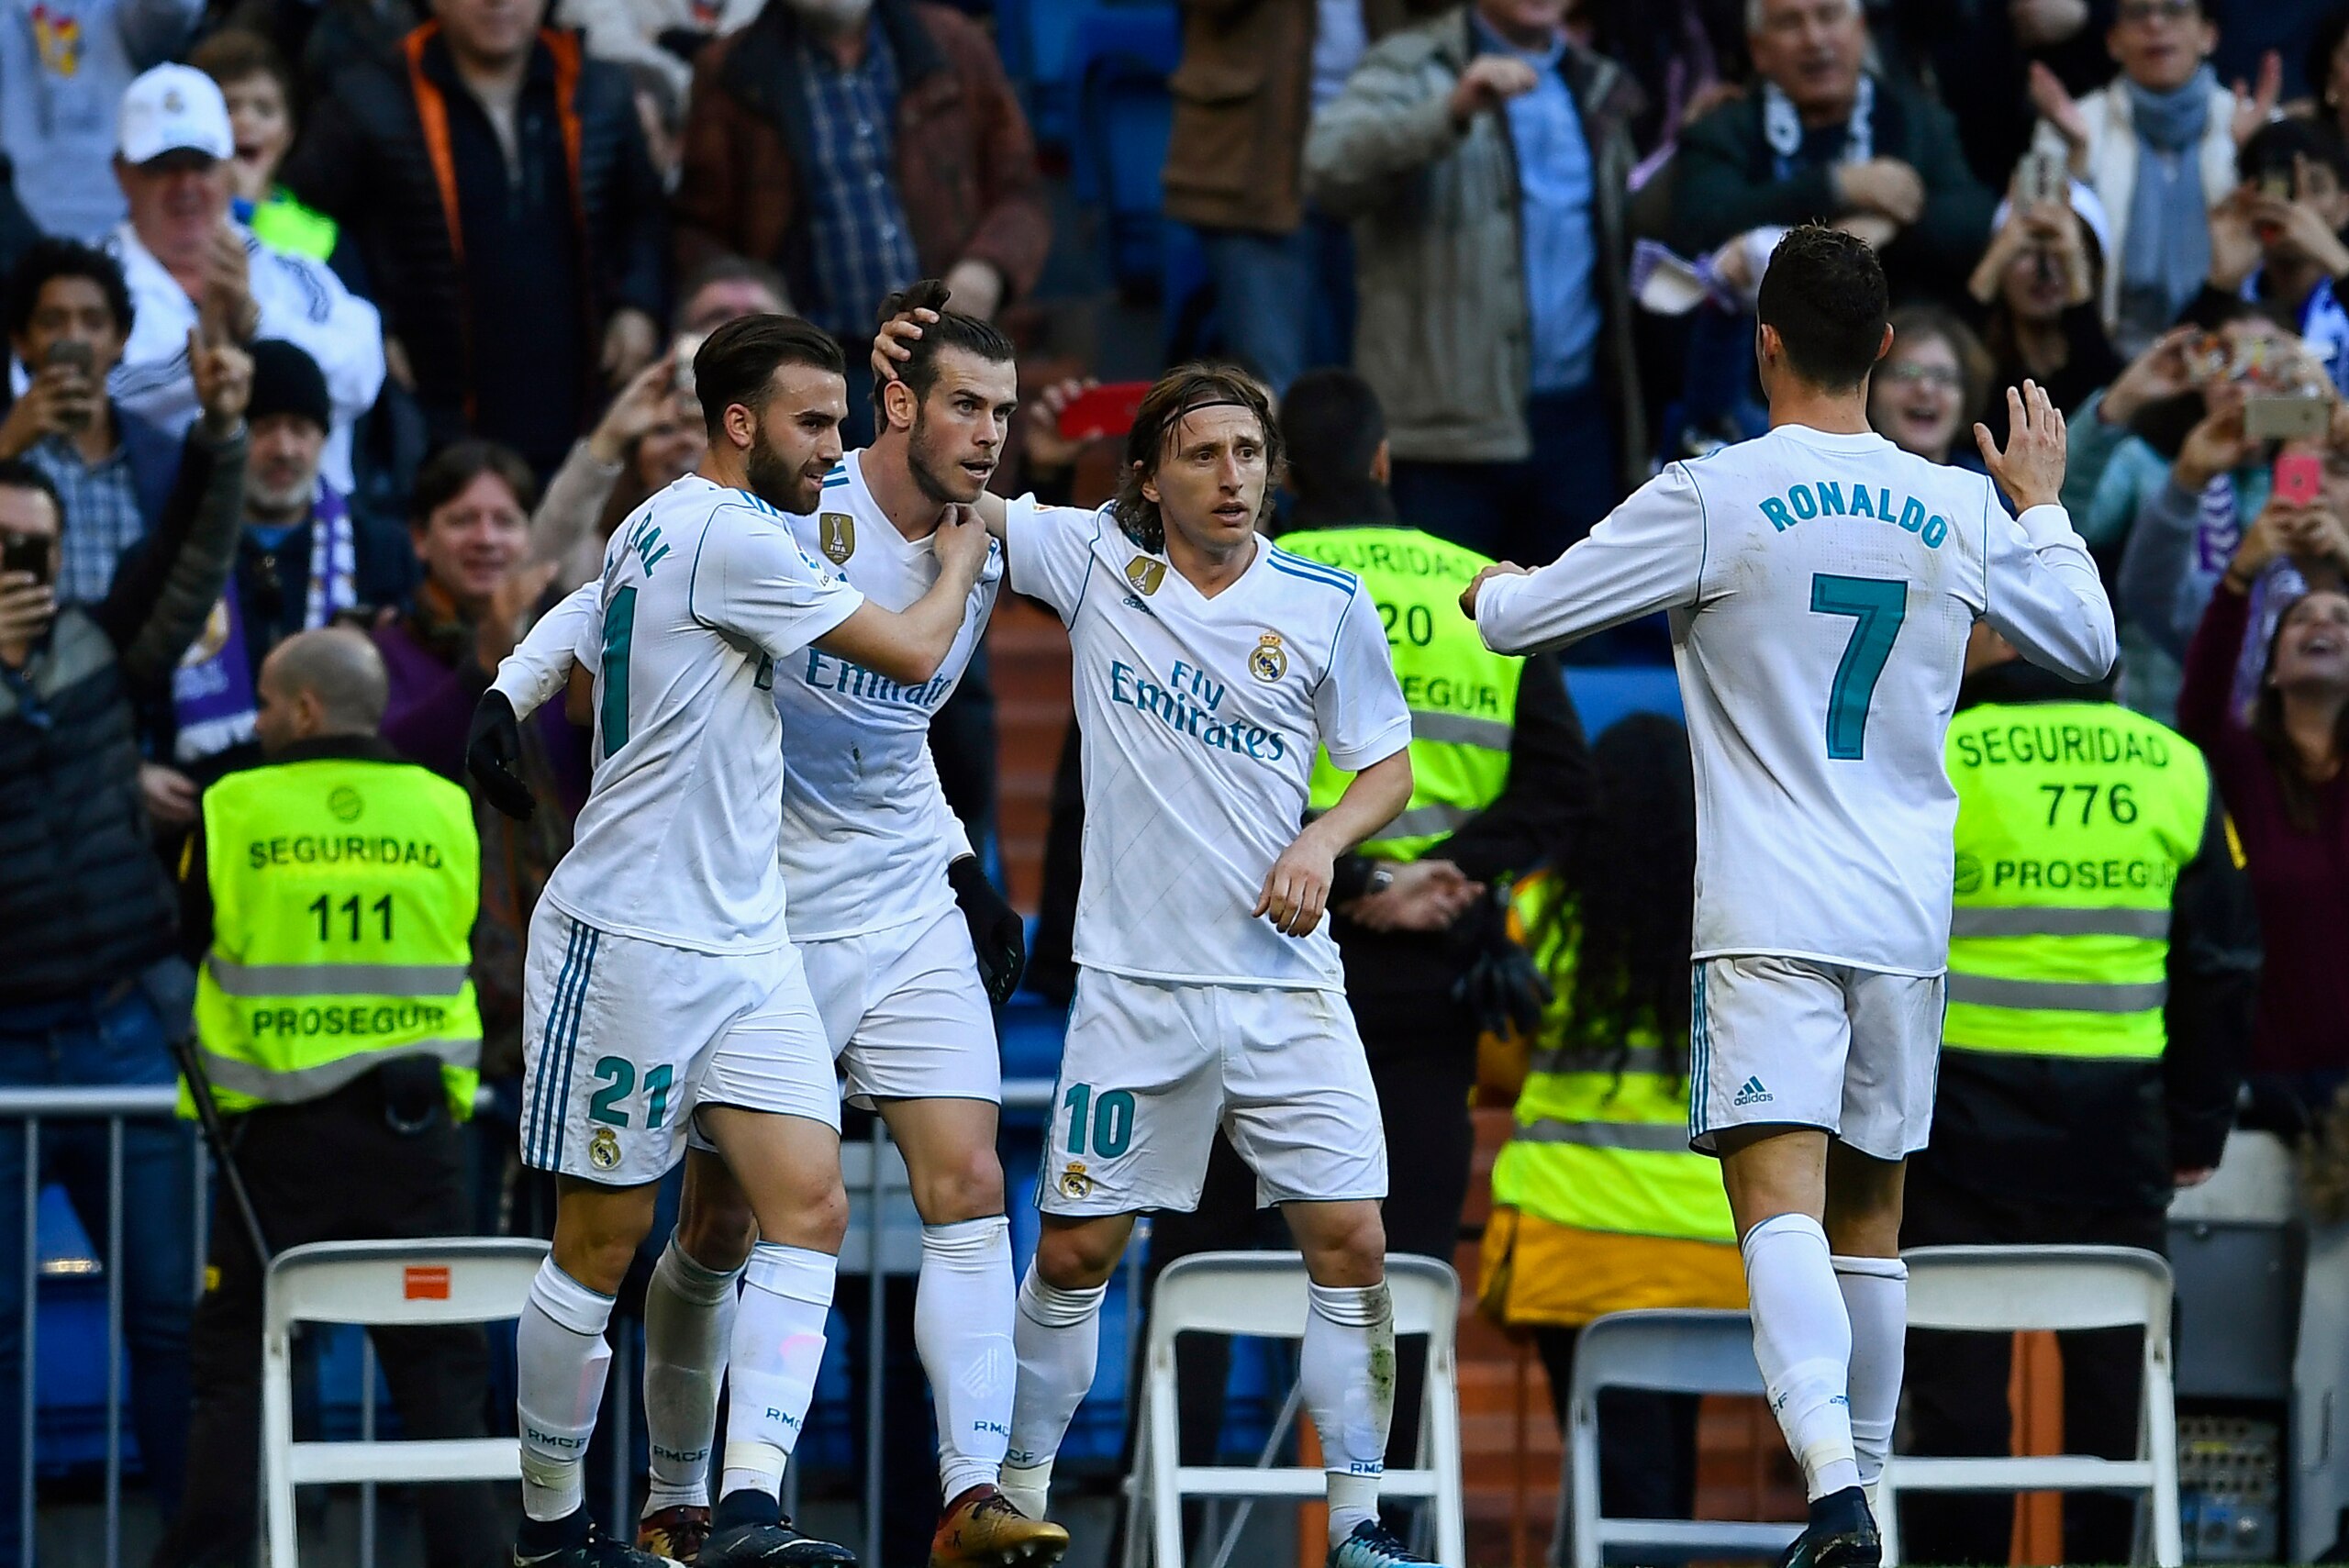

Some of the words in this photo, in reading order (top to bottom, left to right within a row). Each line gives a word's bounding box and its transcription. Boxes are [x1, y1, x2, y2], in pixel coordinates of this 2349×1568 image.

[1759, 482, 1948, 549] RONALDO
[805, 646, 953, 707] Emirate
[1171, 660, 1225, 711] Fly
[1809, 573, 1909, 761] 7
[1111, 660, 1285, 761] Emirates
[1403, 675, 1498, 713] EGUR
[1957, 725, 2169, 768] SEGURIDAD
[2040, 783, 2138, 827] 776
[250, 836, 442, 870] SEGURIDAD
[308, 894, 393, 942] 111
[253, 1006, 445, 1038] PROSEGUR
[588, 1056, 674, 1129] 21
[1733, 1093, 1774, 1106] adidas
[1063, 1083, 1135, 1159] 10
[527, 1428, 588, 1449] RMCF
[765, 1407, 802, 1432] RMC
[974, 1420, 1009, 1437] RMC
[652, 1445, 709, 1463] RMCF
[1350, 1462, 1384, 1473] RMC
